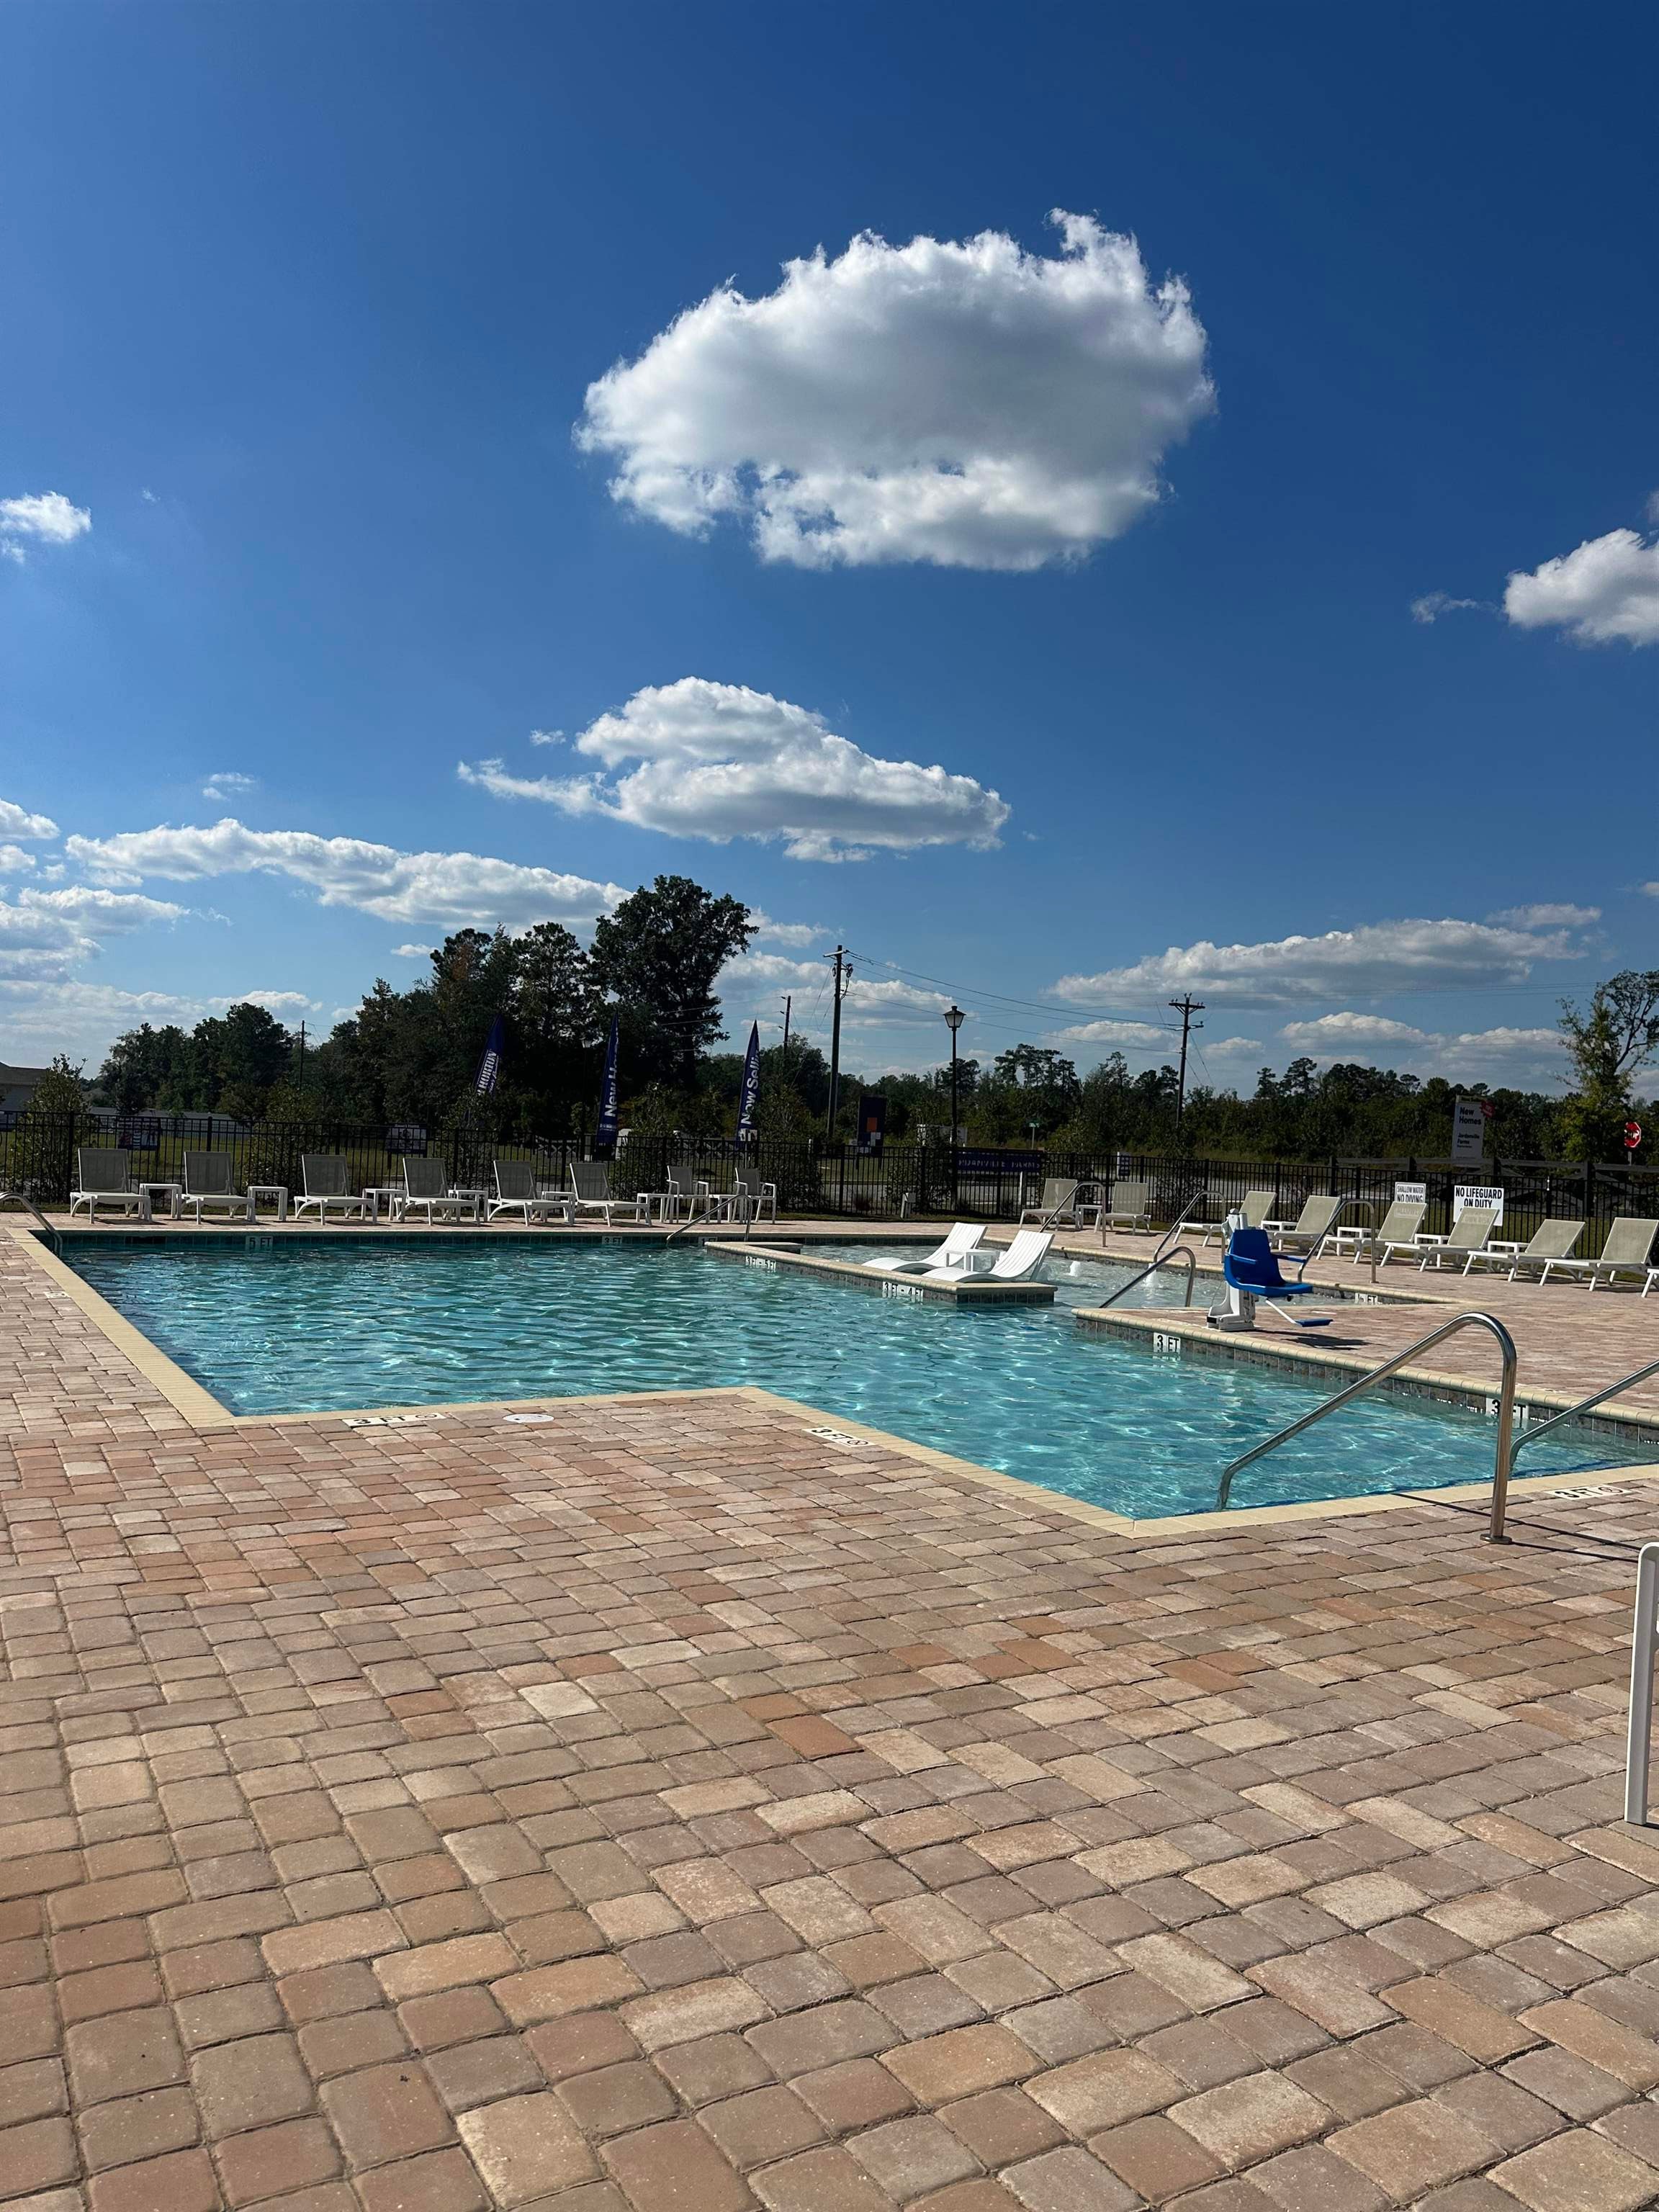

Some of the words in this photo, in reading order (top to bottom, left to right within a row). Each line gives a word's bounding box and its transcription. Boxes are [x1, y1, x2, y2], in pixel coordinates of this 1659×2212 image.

[1460, 1107, 1474, 1115] New
[1459, 1116, 1482, 1125] Homes
[1456, 1187, 1465, 1197] NO
[1466, 1187, 1502, 1199] LIFEGUARD
[1464, 1198, 1473, 1207] ON
[1475, 1199, 1493, 1208] DUTY
[1156, 1334, 1164, 1352] 3
[1168, 1336, 1179, 1352] FT
[1492, 1399, 1501, 1415] 3
